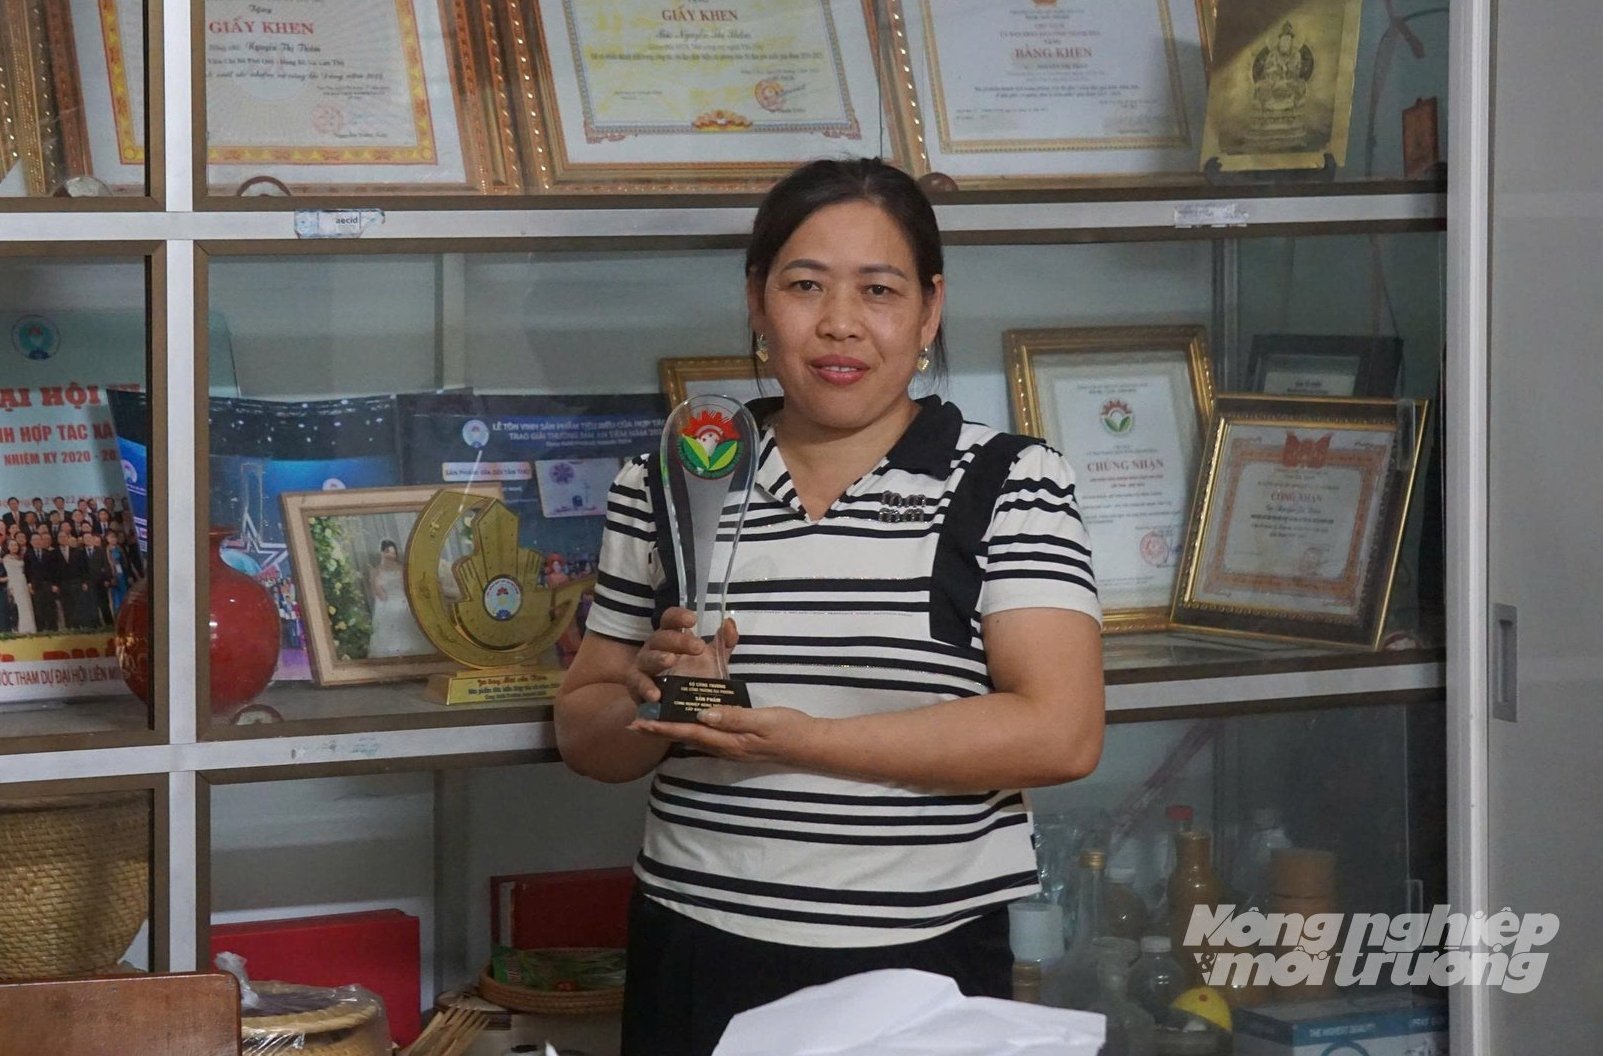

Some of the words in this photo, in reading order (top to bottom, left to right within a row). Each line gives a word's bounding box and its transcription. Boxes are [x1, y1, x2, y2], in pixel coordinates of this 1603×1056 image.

[661, 4, 694, 21] GIẤY
[699, 9, 738, 21] KHEN
[208, 15, 254, 34] GIẤY
[262, 21, 314, 34] KHEN
[1014, 43, 1052, 59] BẰNG
[1055, 47, 1093, 58] KHEN
[336, 216, 358, 224] aecid
[39, 381, 102, 409] HỘI
[20, 423, 52, 446] HỢP
[57, 422, 89, 441] TÁC
[4, 452, 40, 467] NHIỆM
[43, 450, 57, 465] KỲ
[62, 450, 91, 464] 2020
[1087, 458, 1129, 472] CHỨNG
[1132, 458, 1164, 471] NHẬN
[15, 671, 40, 685] THAM
